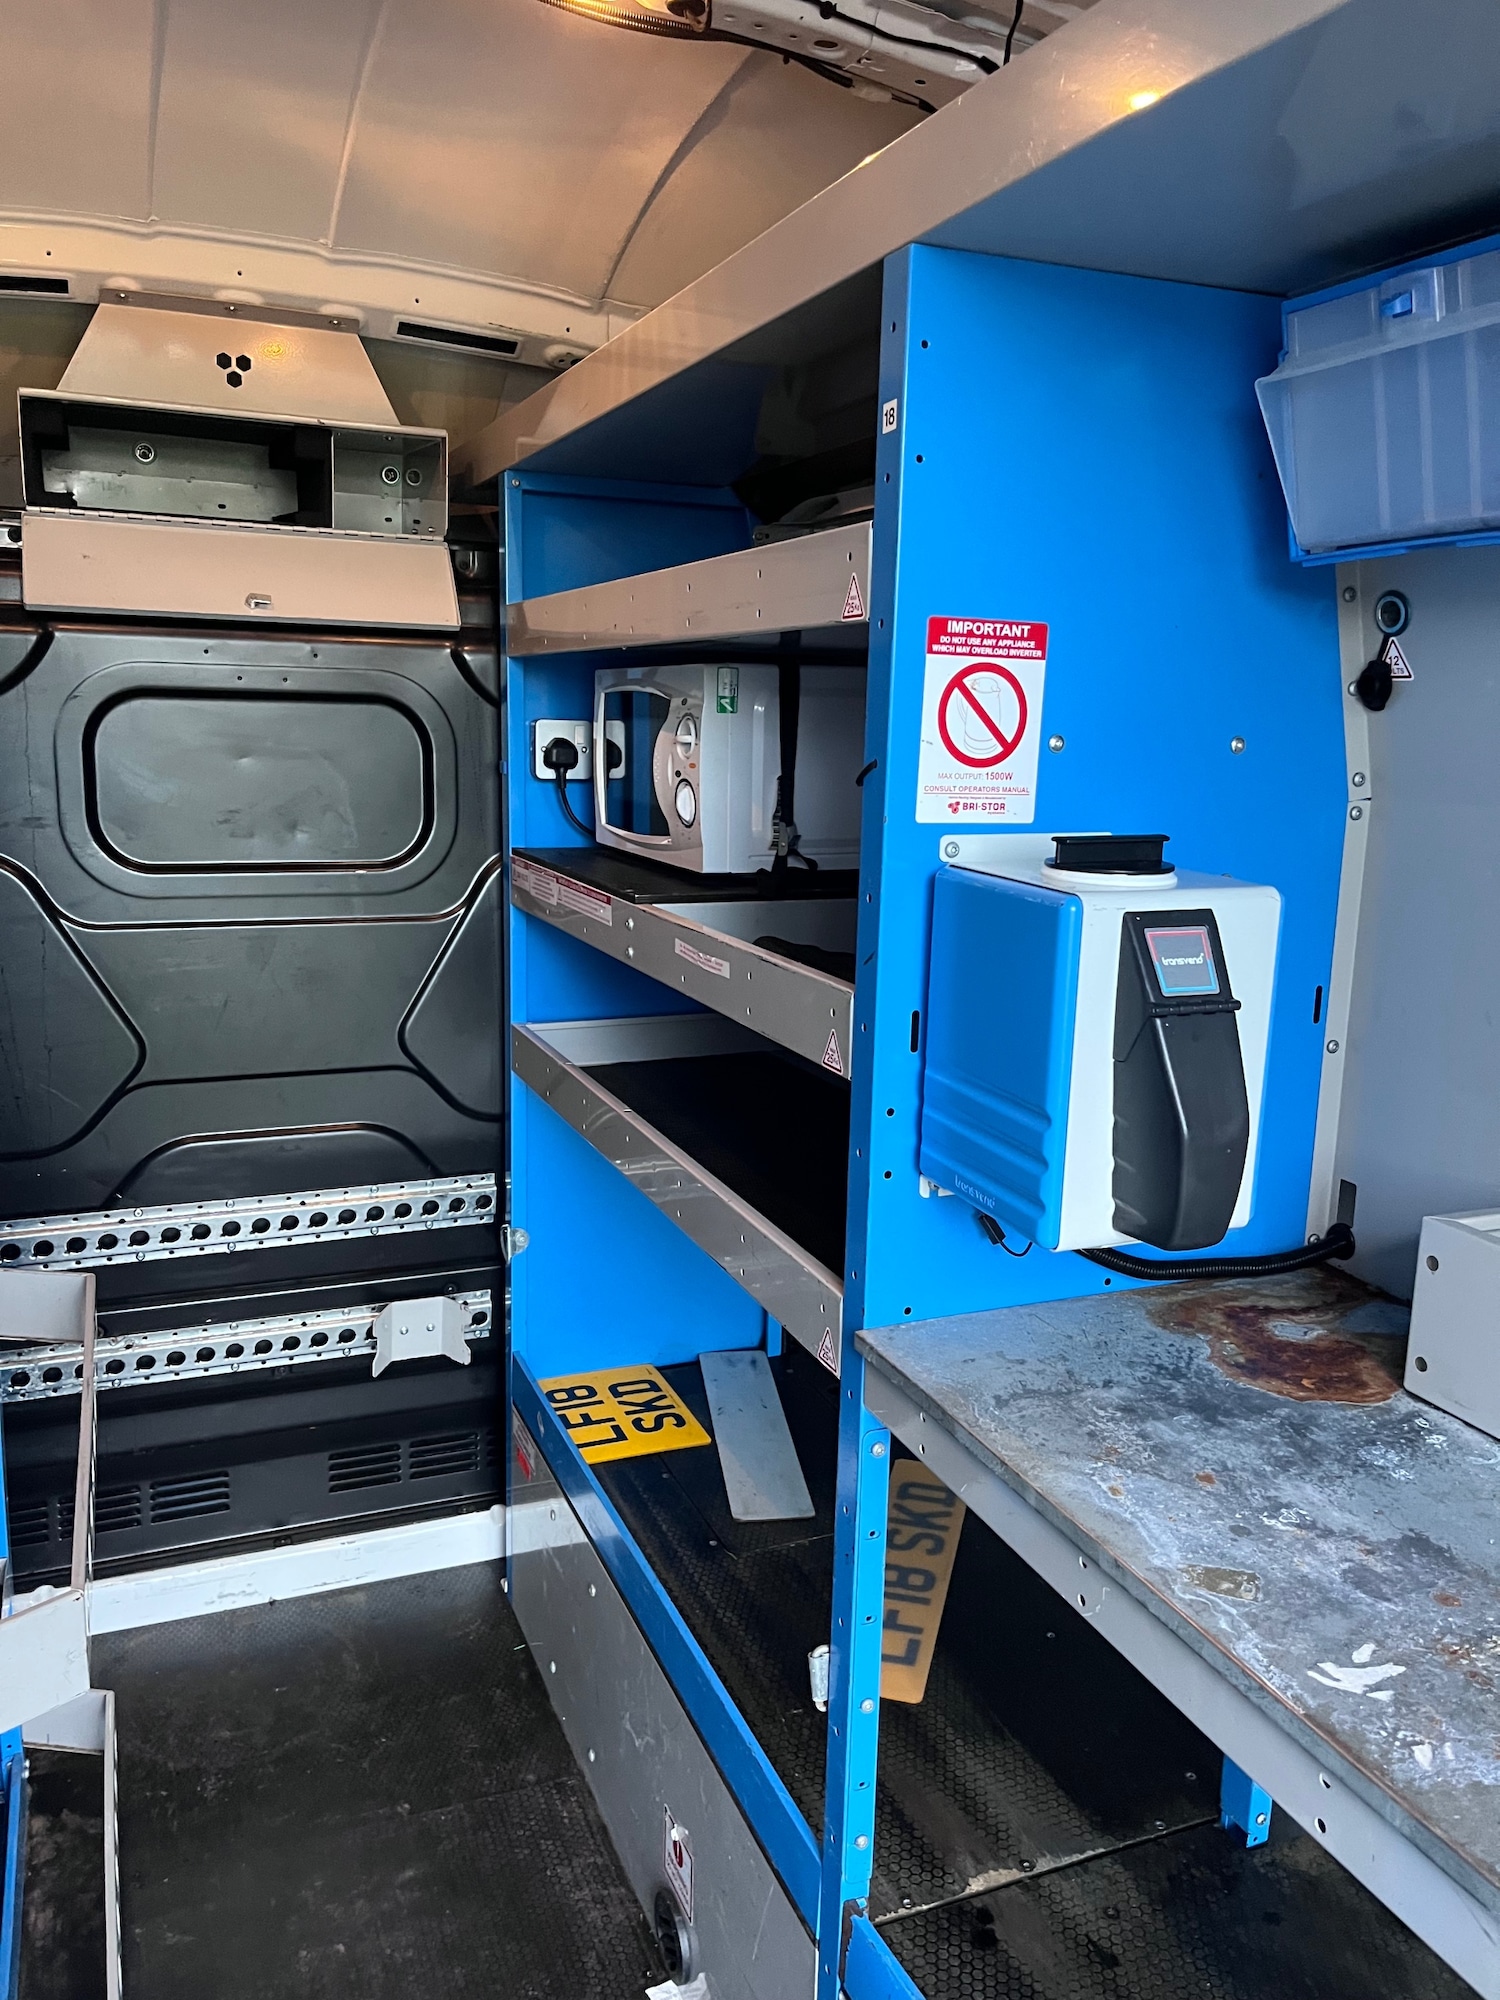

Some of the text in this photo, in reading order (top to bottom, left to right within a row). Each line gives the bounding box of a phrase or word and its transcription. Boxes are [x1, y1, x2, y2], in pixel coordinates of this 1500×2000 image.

[884, 407, 895, 427] 18
[947, 620, 1031, 638] IMPORTANT
[940, 635, 1035, 649] DO NOT USE ANY APPLIANCE
[932, 644, 1042, 658] WHICH MAY OVERLOAD INVERTER
[1388, 655, 1400, 666] 12
[954, 773, 984, 781] OUTPUT:
[985, 772, 1013, 781] 1500W
[962, 802, 1006, 811] BRI-STOR
[1161, 953, 1204, 966] transvend
[607, 1379, 687, 1433] SKD
[545, 1385, 629, 1449] LF18
[887, 1481, 957, 1557] SKD
